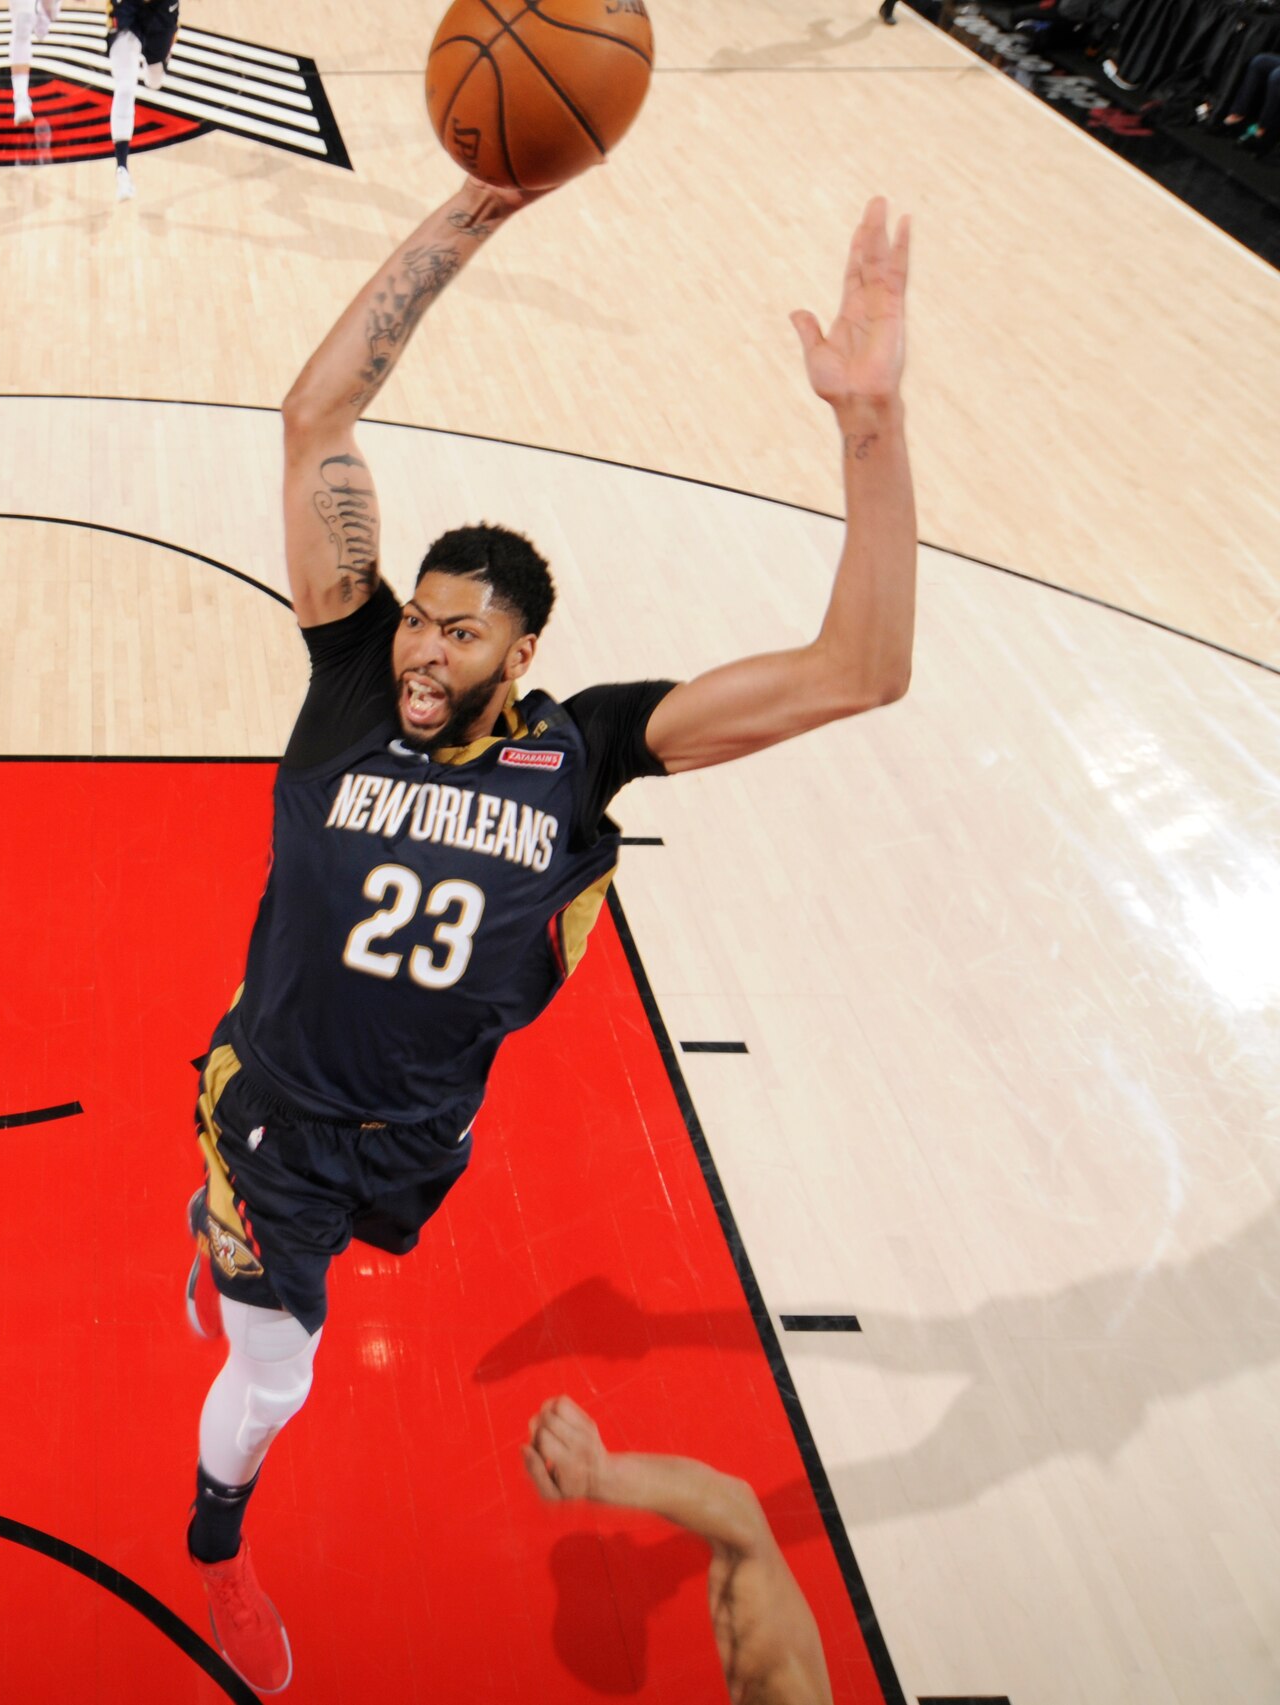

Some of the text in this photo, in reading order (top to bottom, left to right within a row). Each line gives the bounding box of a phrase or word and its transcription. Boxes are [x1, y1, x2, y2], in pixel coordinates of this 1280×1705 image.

[325, 773, 558, 873] NEW ORLEANS
[341, 862, 486, 990] 23
